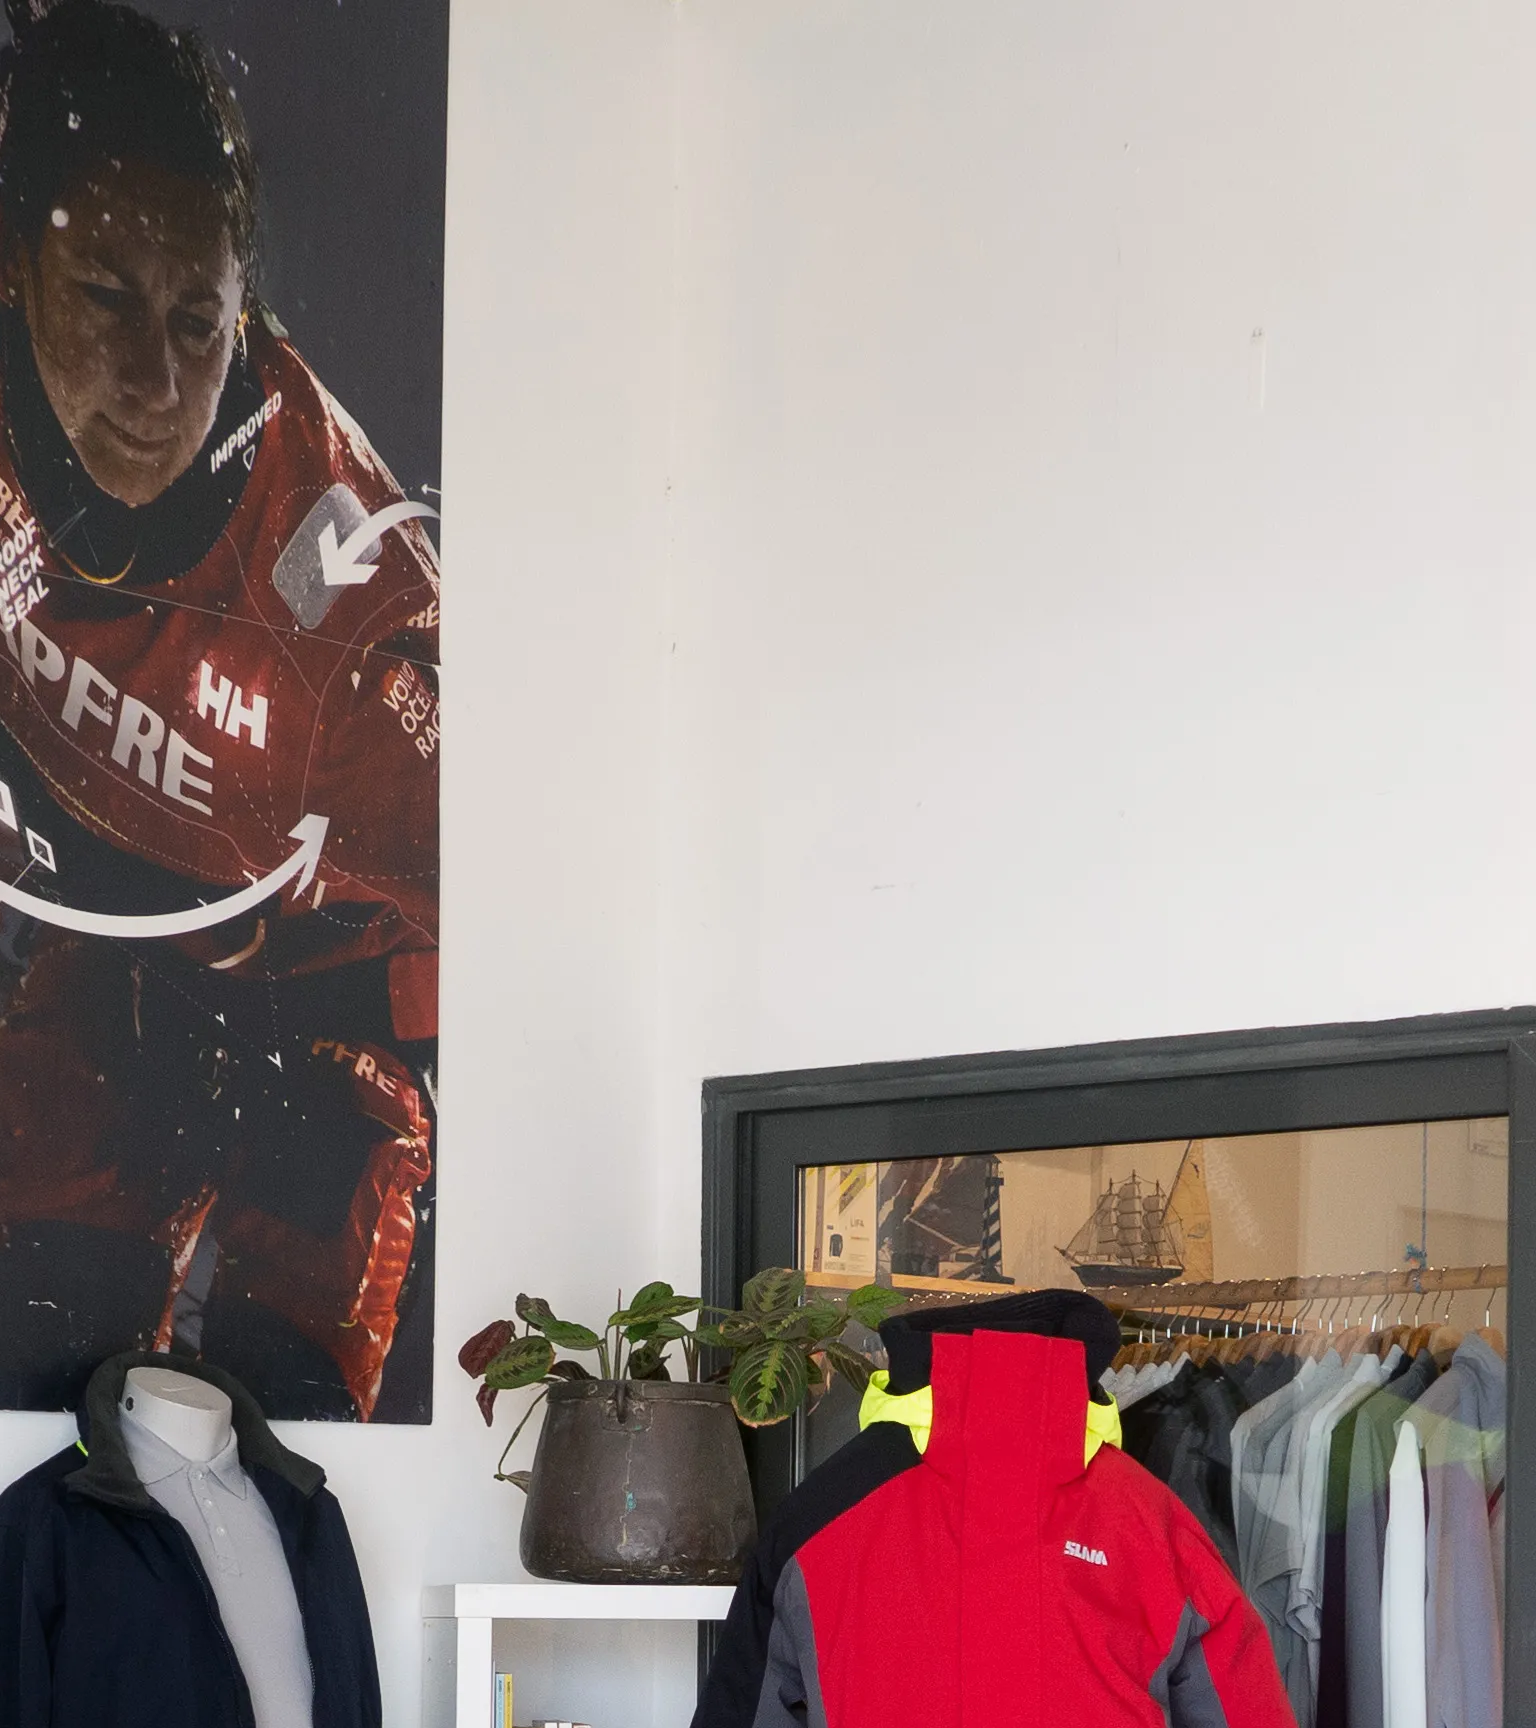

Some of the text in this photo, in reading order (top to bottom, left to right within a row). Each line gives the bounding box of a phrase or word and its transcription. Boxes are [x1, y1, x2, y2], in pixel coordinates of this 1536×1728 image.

[210, 391, 283, 473] IMPROVED
[2, 576, 50, 633] SEAL
[197, 659, 268, 750] HH
[1064, 1540, 1109, 1567] SLAM
